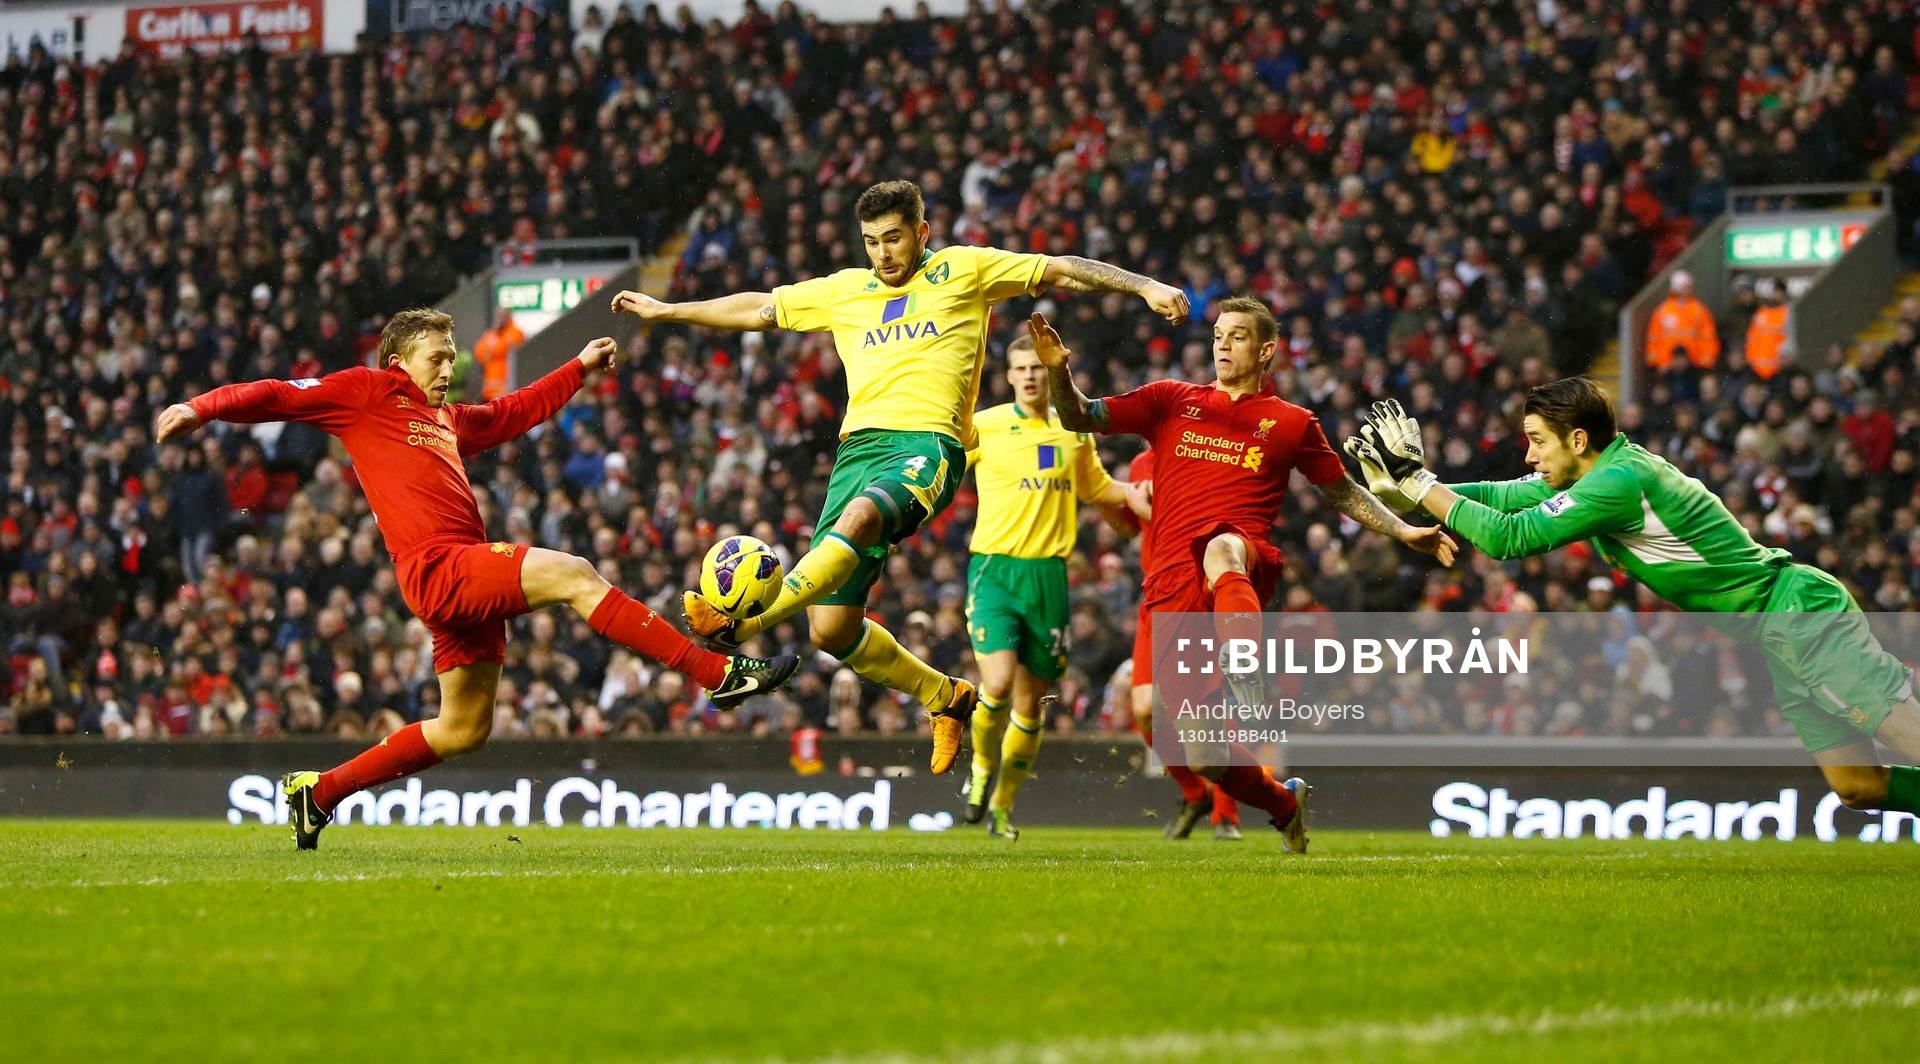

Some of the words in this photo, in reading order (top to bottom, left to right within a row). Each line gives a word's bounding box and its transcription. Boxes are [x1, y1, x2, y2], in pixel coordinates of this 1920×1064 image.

[863, 321, 940, 349] AVIVA
[1181, 430, 1246, 452] Standard
[1175, 444, 1241, 466] Chartered
[1019, 477, 1072, 492] AVIVA
[544, 776, 891, 830] Chartered
[1430, 781, 1798, 840] Standard
